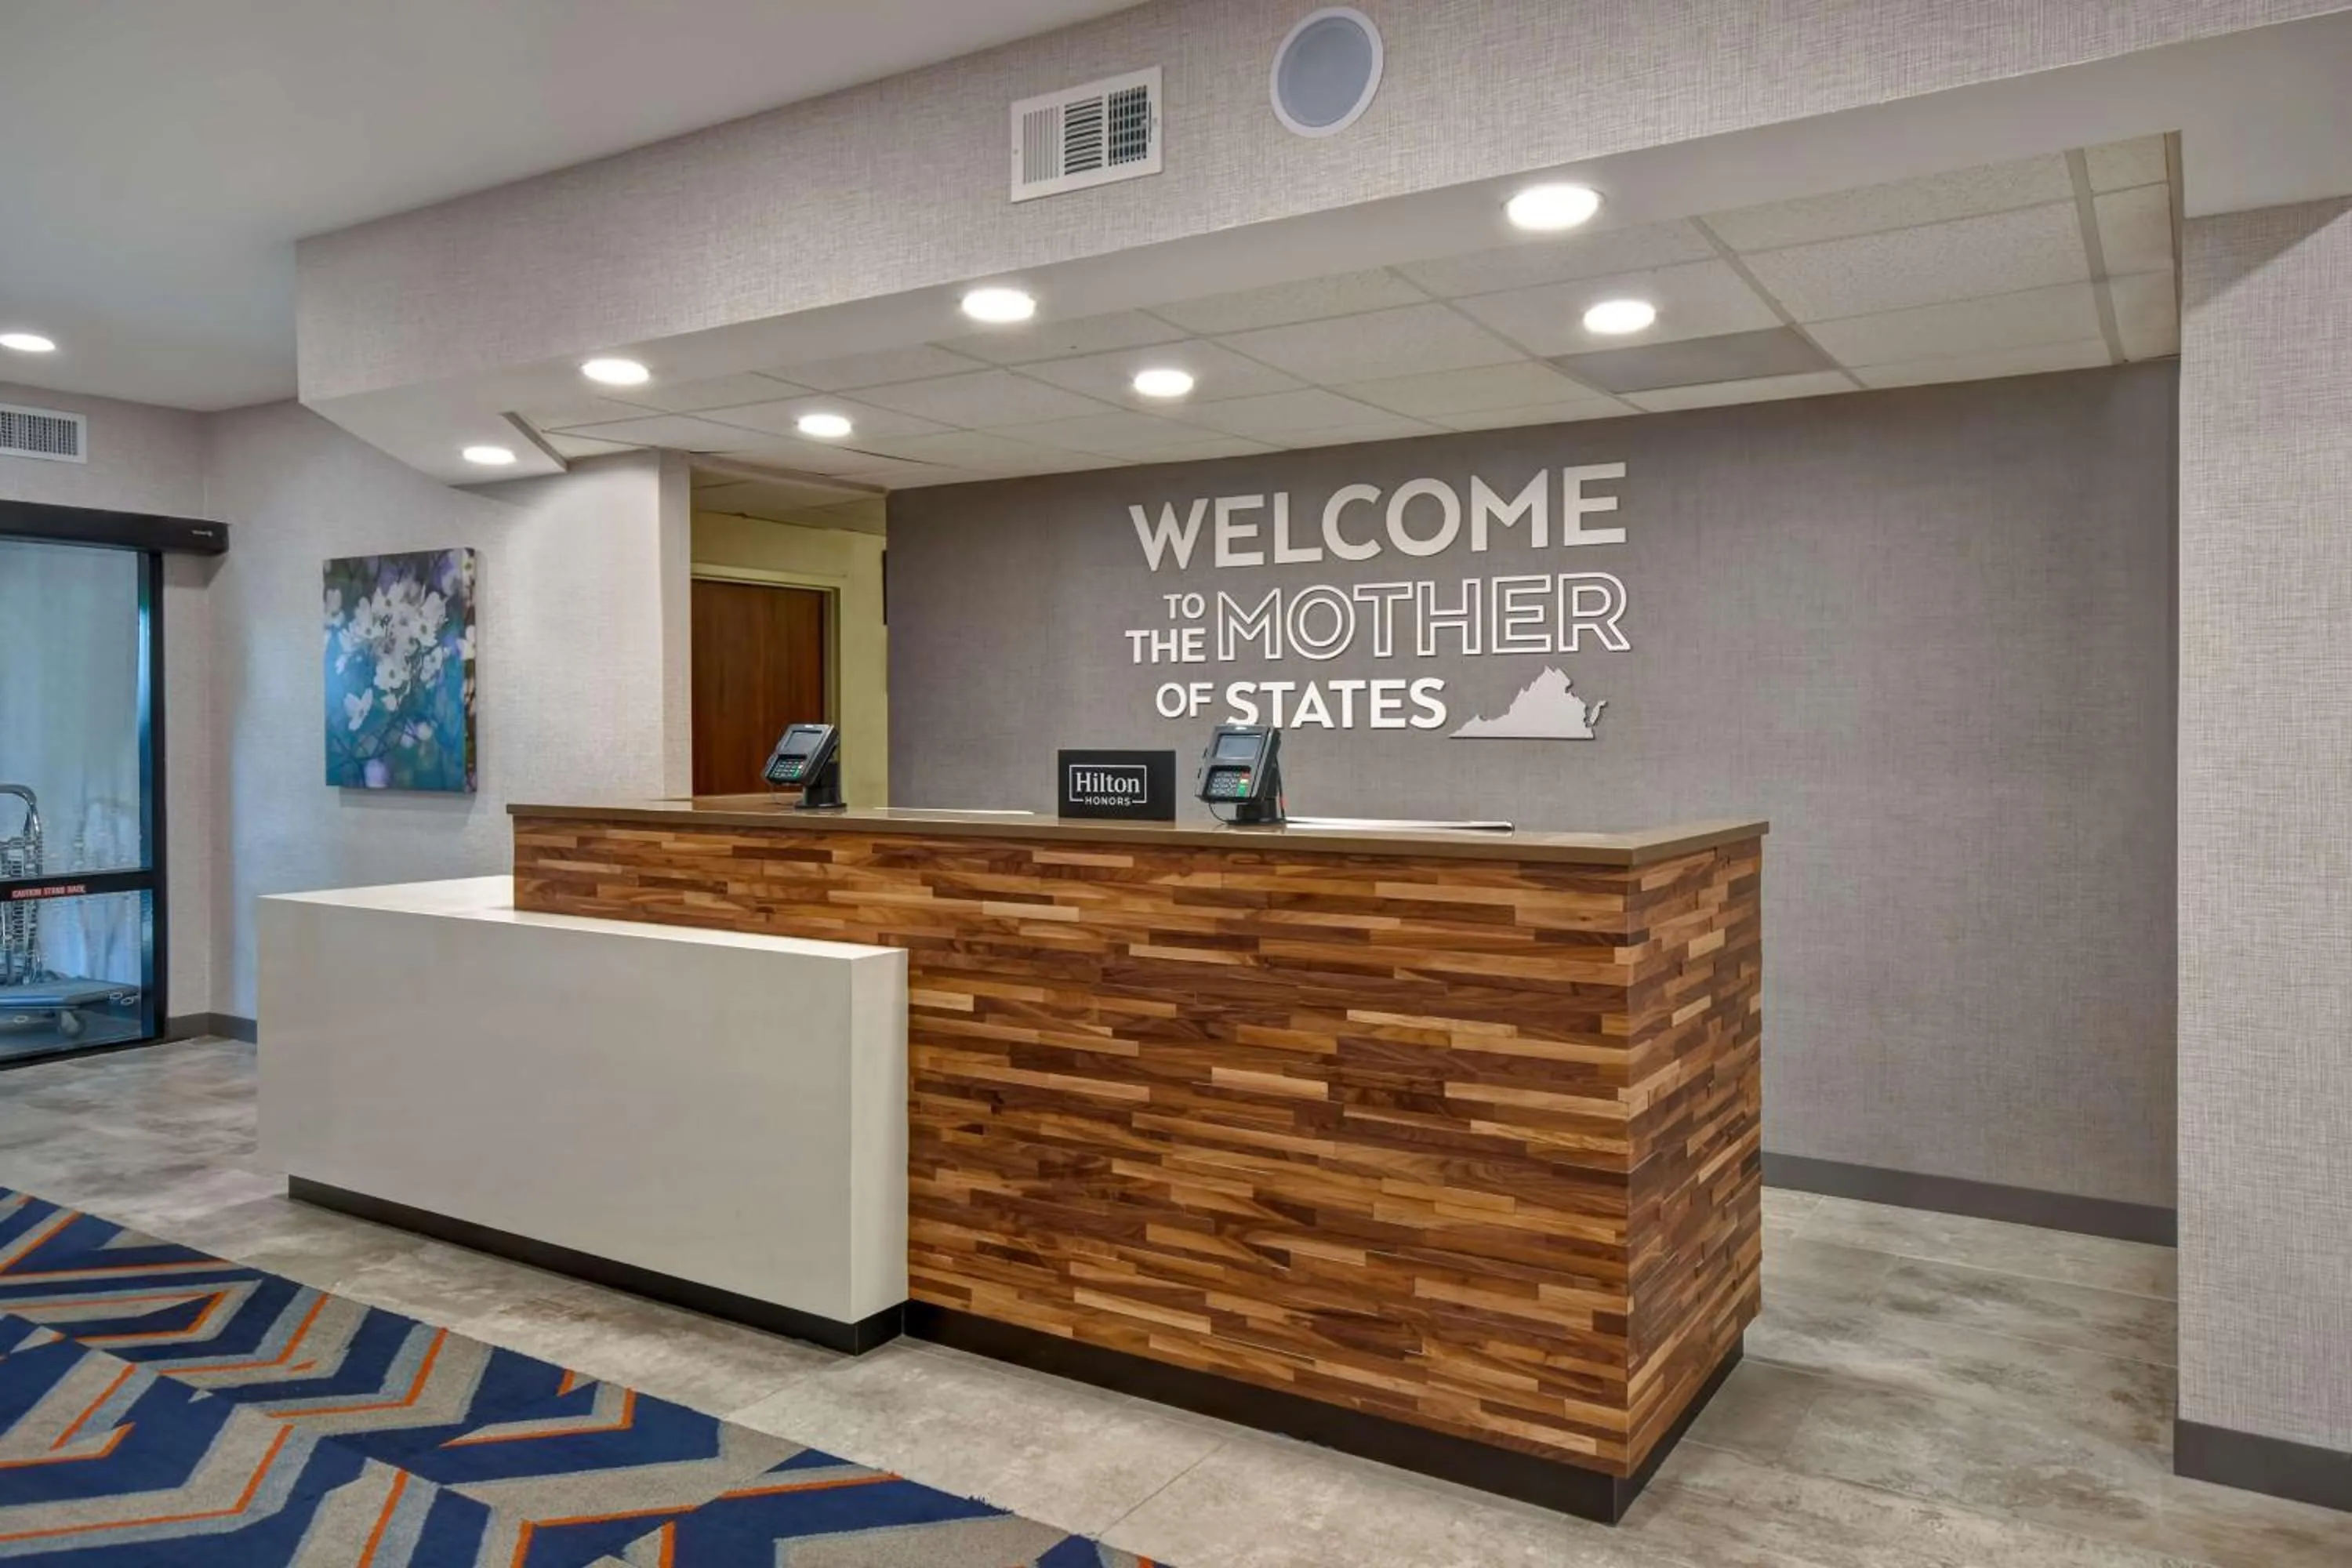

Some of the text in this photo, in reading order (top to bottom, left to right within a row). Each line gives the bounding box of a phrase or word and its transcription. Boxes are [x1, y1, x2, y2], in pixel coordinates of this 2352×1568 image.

[1128, 462, 1627, 572] WELCOME
[1125, 572, 1631, 664] THE MOTHER
[1163, 593, 1206, 619] TO
[1156, 677, 1447, 730] OF STATES
[1076, 771, 1140, 793] Hilton
[1084, 796, 1131, 806] HONORS
